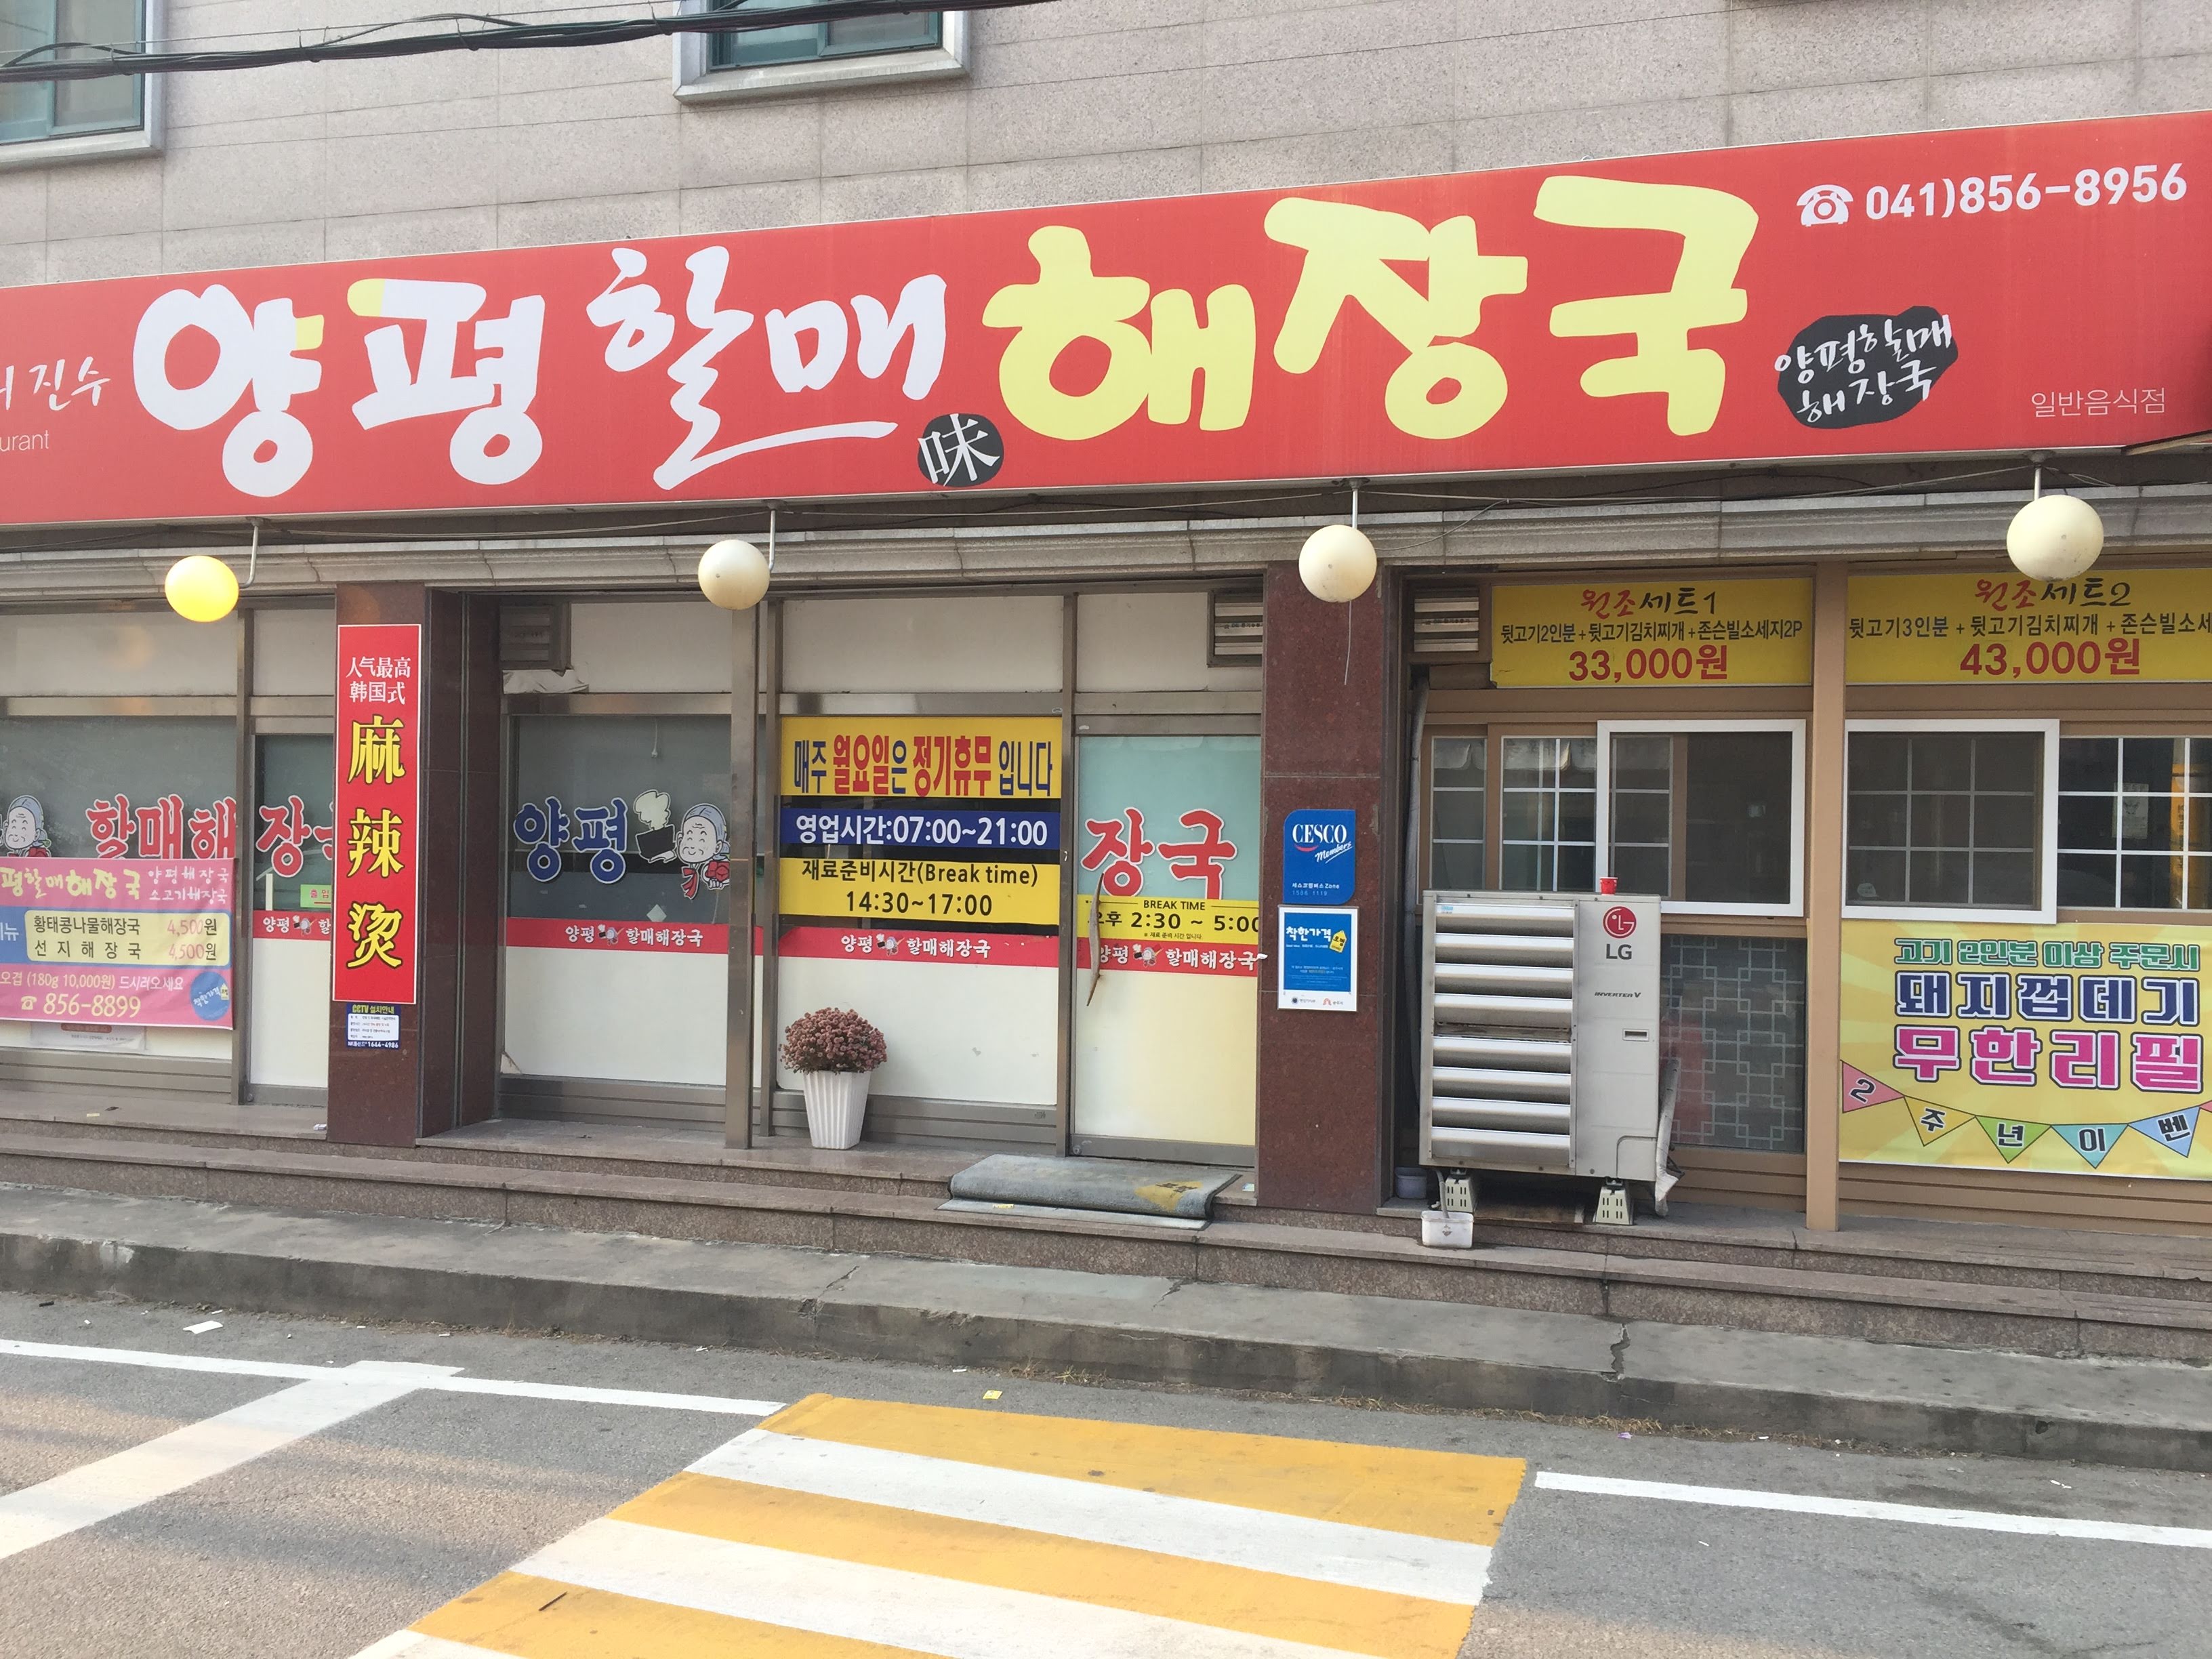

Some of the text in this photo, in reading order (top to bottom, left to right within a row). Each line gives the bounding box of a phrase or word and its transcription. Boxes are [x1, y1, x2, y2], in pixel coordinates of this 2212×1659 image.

[1866, 163, 2187, 220] 041)856-8956
[982, 176, 1759, 441] 해장국
[29, 356, 110, 411] 진수
[1797, 359, 1937, 423] 해장국
[2031, 388, 2166, 417] 일반음식점
[918, 413, 1000, 486] 味
[346, 656, 411, 678] 人气最高
[1569, 644, 1728, 683] 33,000원
[1960, 638, 2140, 679] 43,000원
[349, 680, 405, 705] 韩国式
[794, 735, 1052, 798] 매주 월요일은 정기휴무 입니다
[347, 715, 405, 968] 麻辣烫
[513, 796, 628, 884] 양평
[1292, 823, 1347, 844] CESCO
[1081, 807, 1237, 900] 장국
[1315, 841, 1353, 863] Members
[986, 864, 1039, 887] time)
[149, 888, 228, 904] 소고기해장국
[846, 891, 993, 916] 14:30~17:00
[1143, 900, 1206, 911] BREAK TIME
[0, 922, 19, 941] 뉴
[34, 915, 141, 934] 황태콩나물해장국
[263, 917, 289, 933] 양평
[1131, 913, 1181, 929] 2:30
[565, 925, 704, 947] 양평 할매해장국
[841, 934, 991, 958] 양평 할매해장국
[1286, 926, 1332, 942] 착한가격
[1165, 948, 1256, 971] 할매해장국
[1605, 943, 1633, 960] LG
[1894, 938, 2200, 972] 고기 2인분 이상 주문시
[27, 972, 59, 989] (180g
[63, 974, 115, 990] 10,000원)
[43, 993, 141, 1018] 856-8899
[352, 1004, 369, 1013] CCTV
[1895, 970, 2200, 1026] 돼지껍데기
[1893, 1025, 2204, 1094] 무한리필
